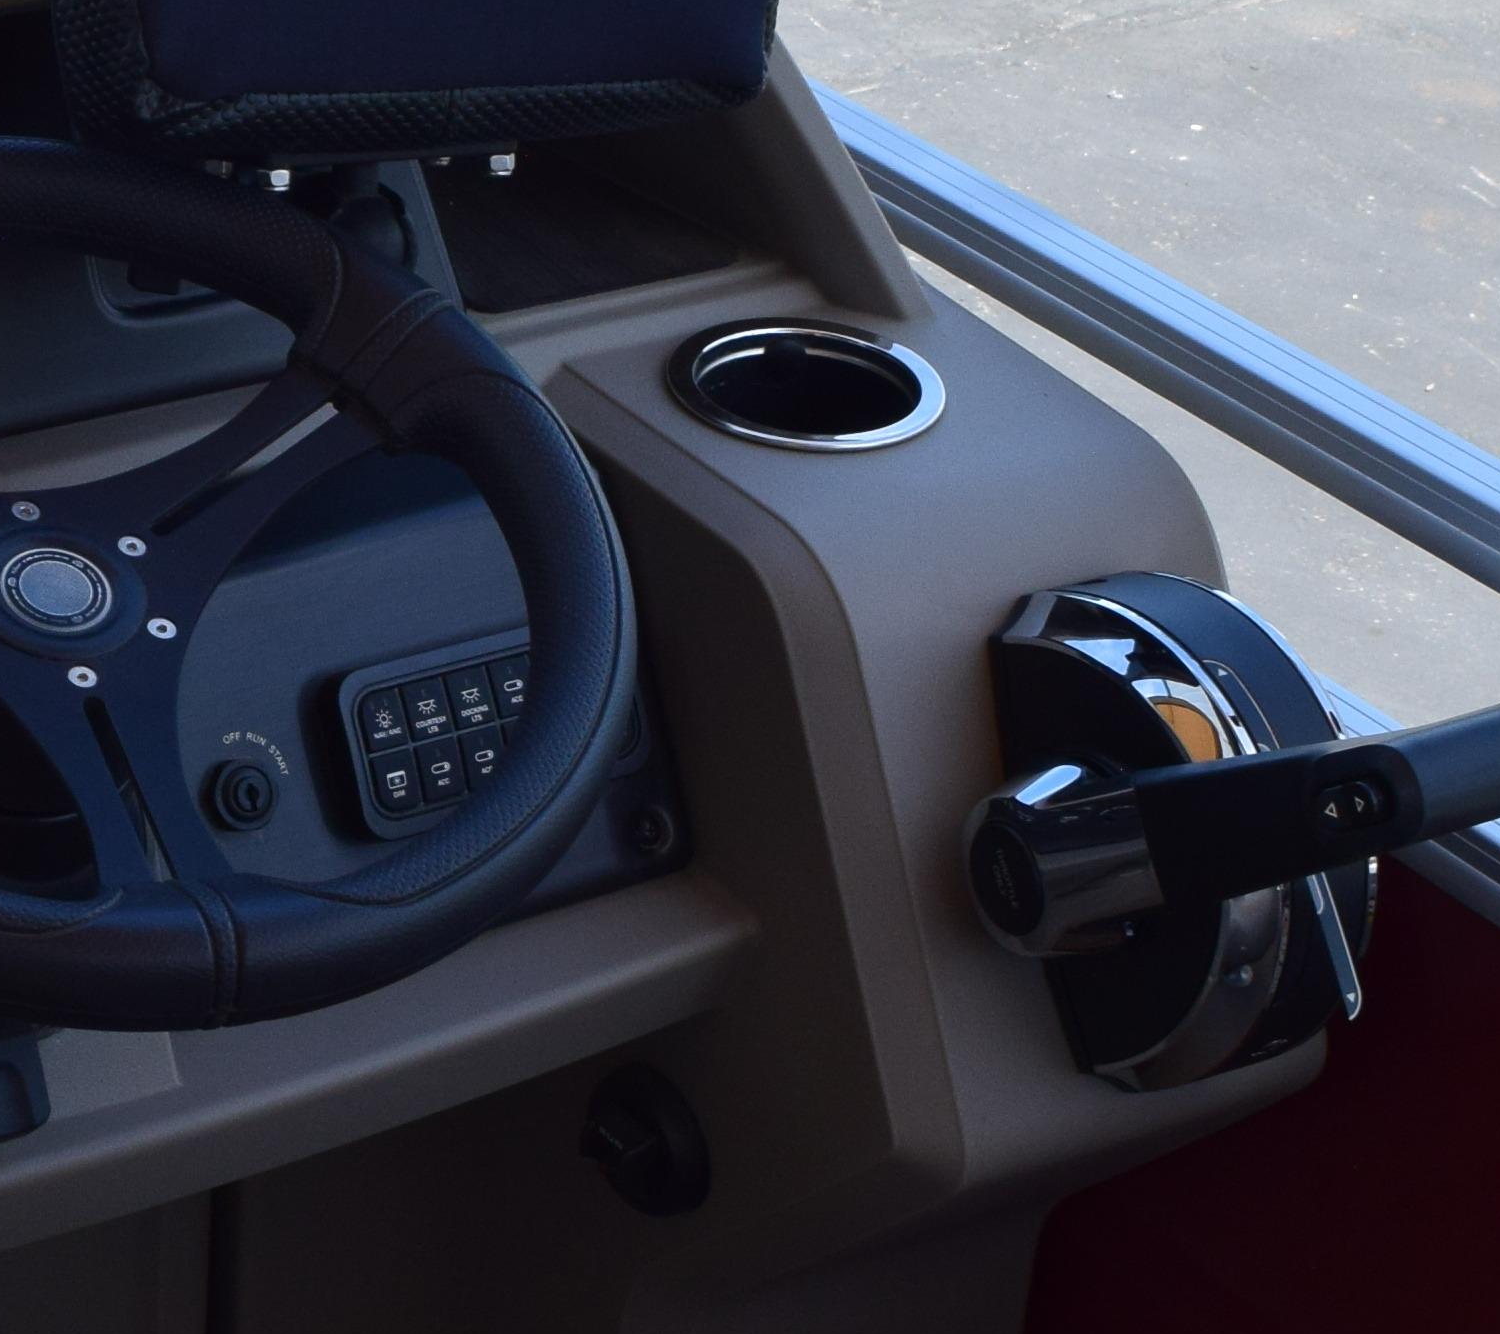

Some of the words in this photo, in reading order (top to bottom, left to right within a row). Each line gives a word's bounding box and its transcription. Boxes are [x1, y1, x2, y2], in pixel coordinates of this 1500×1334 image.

[460, 703, 490, 718] DOCKING
[415, 715, 448, 729] COURTESY
[222, 731, 241, 745] OFF
[246, 731, 267, 746] RUN
[267, 744, 290, 777] START
